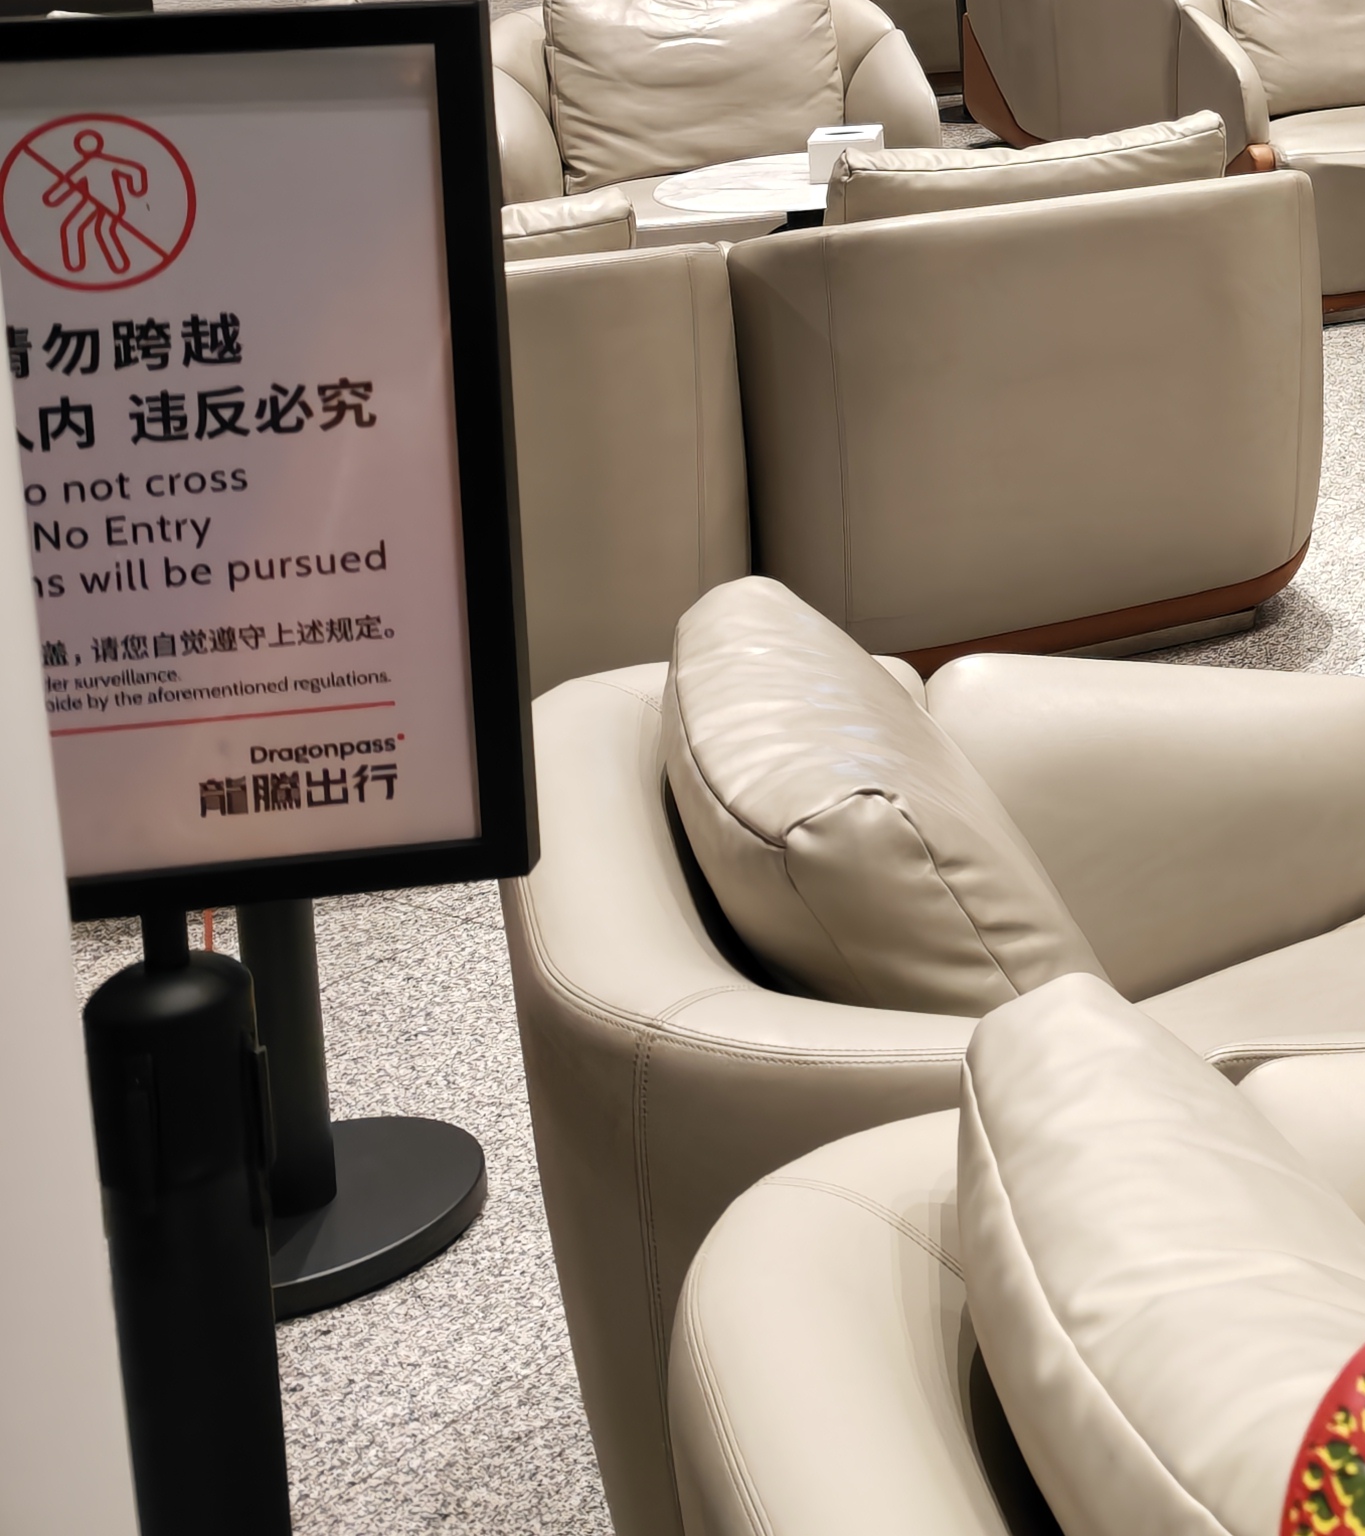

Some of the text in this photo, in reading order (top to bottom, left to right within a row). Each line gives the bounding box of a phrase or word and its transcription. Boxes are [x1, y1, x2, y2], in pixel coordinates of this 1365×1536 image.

[128, 376, 378, 446] 违反必究
[63, 471, 131, 505] not
[145, 467, 249, 498] cross
[33, 514, 212, 553] No Entry
[80, 557, 150, 595] will
[163, 555, 213, 589] be
[227, 538, 388, 593] pursued
[87, 692, 109, 713] by
[114, 689, 143, 708] the
[147, 675, 289, 706] aforementioned
[249, 736, 397, 764] Dragonpass
